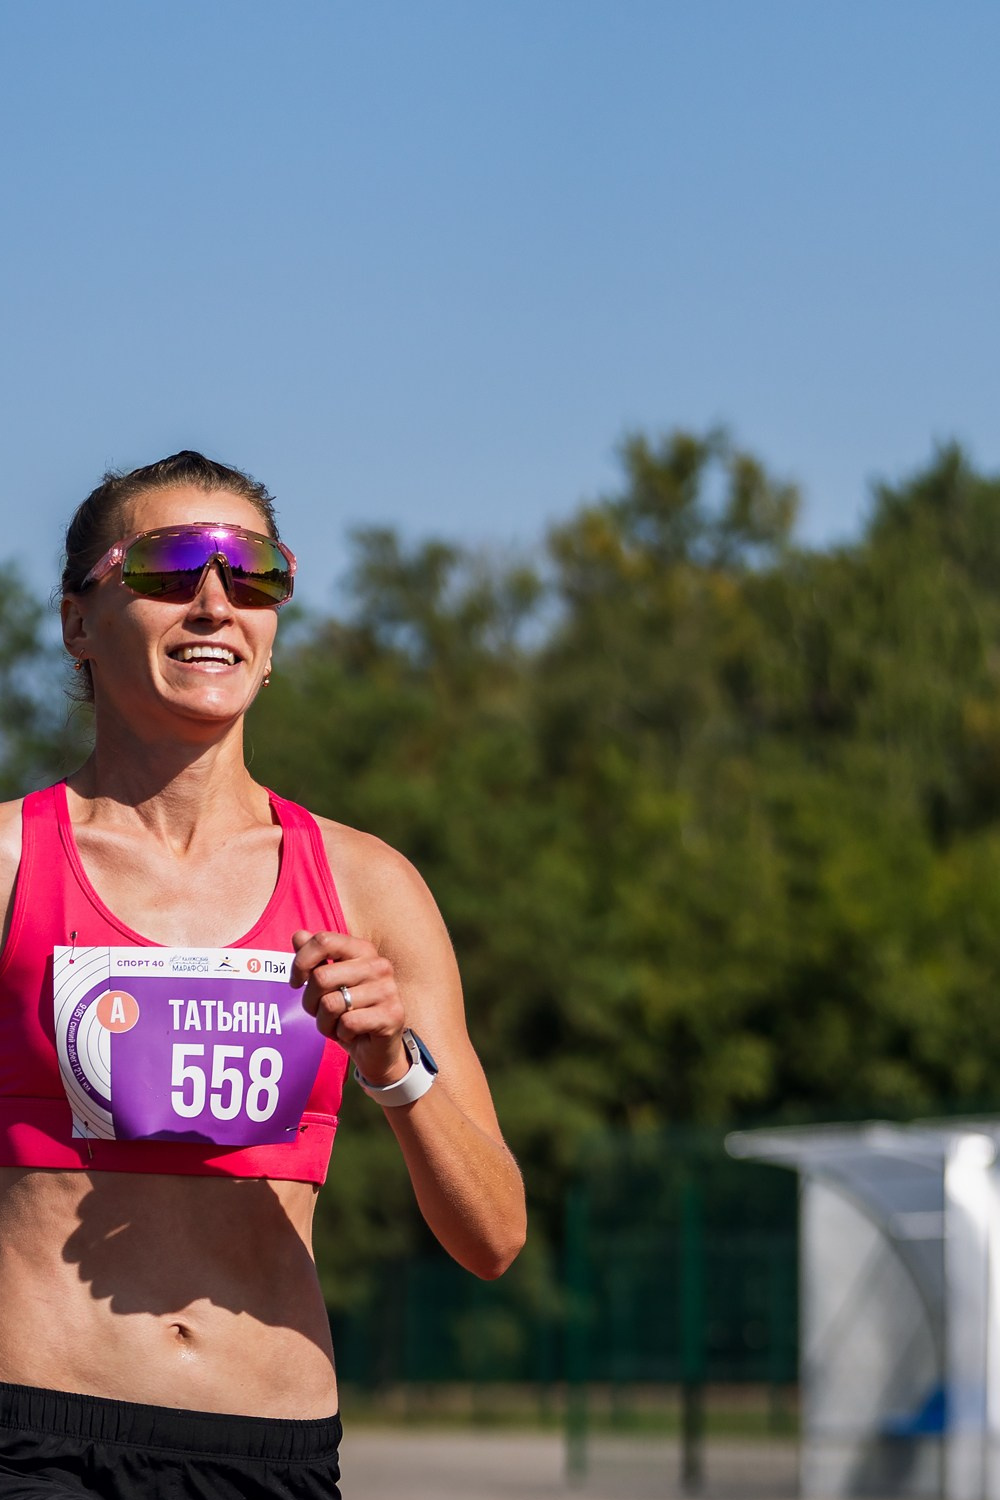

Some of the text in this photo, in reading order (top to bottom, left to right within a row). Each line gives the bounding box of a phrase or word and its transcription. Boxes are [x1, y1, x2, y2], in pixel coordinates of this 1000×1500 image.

[152, 960, 165, 968] 40
[264, 960, 286, 974] Пэй
[169, 999, 282, 1035] ТАТЬЯНА
[68, 1022, 77, 1043] синий
[68, 1044, 77, 1063] забег
[82, 1081, 91, 1092] км
[171, 1043, 283, 1123] 558
